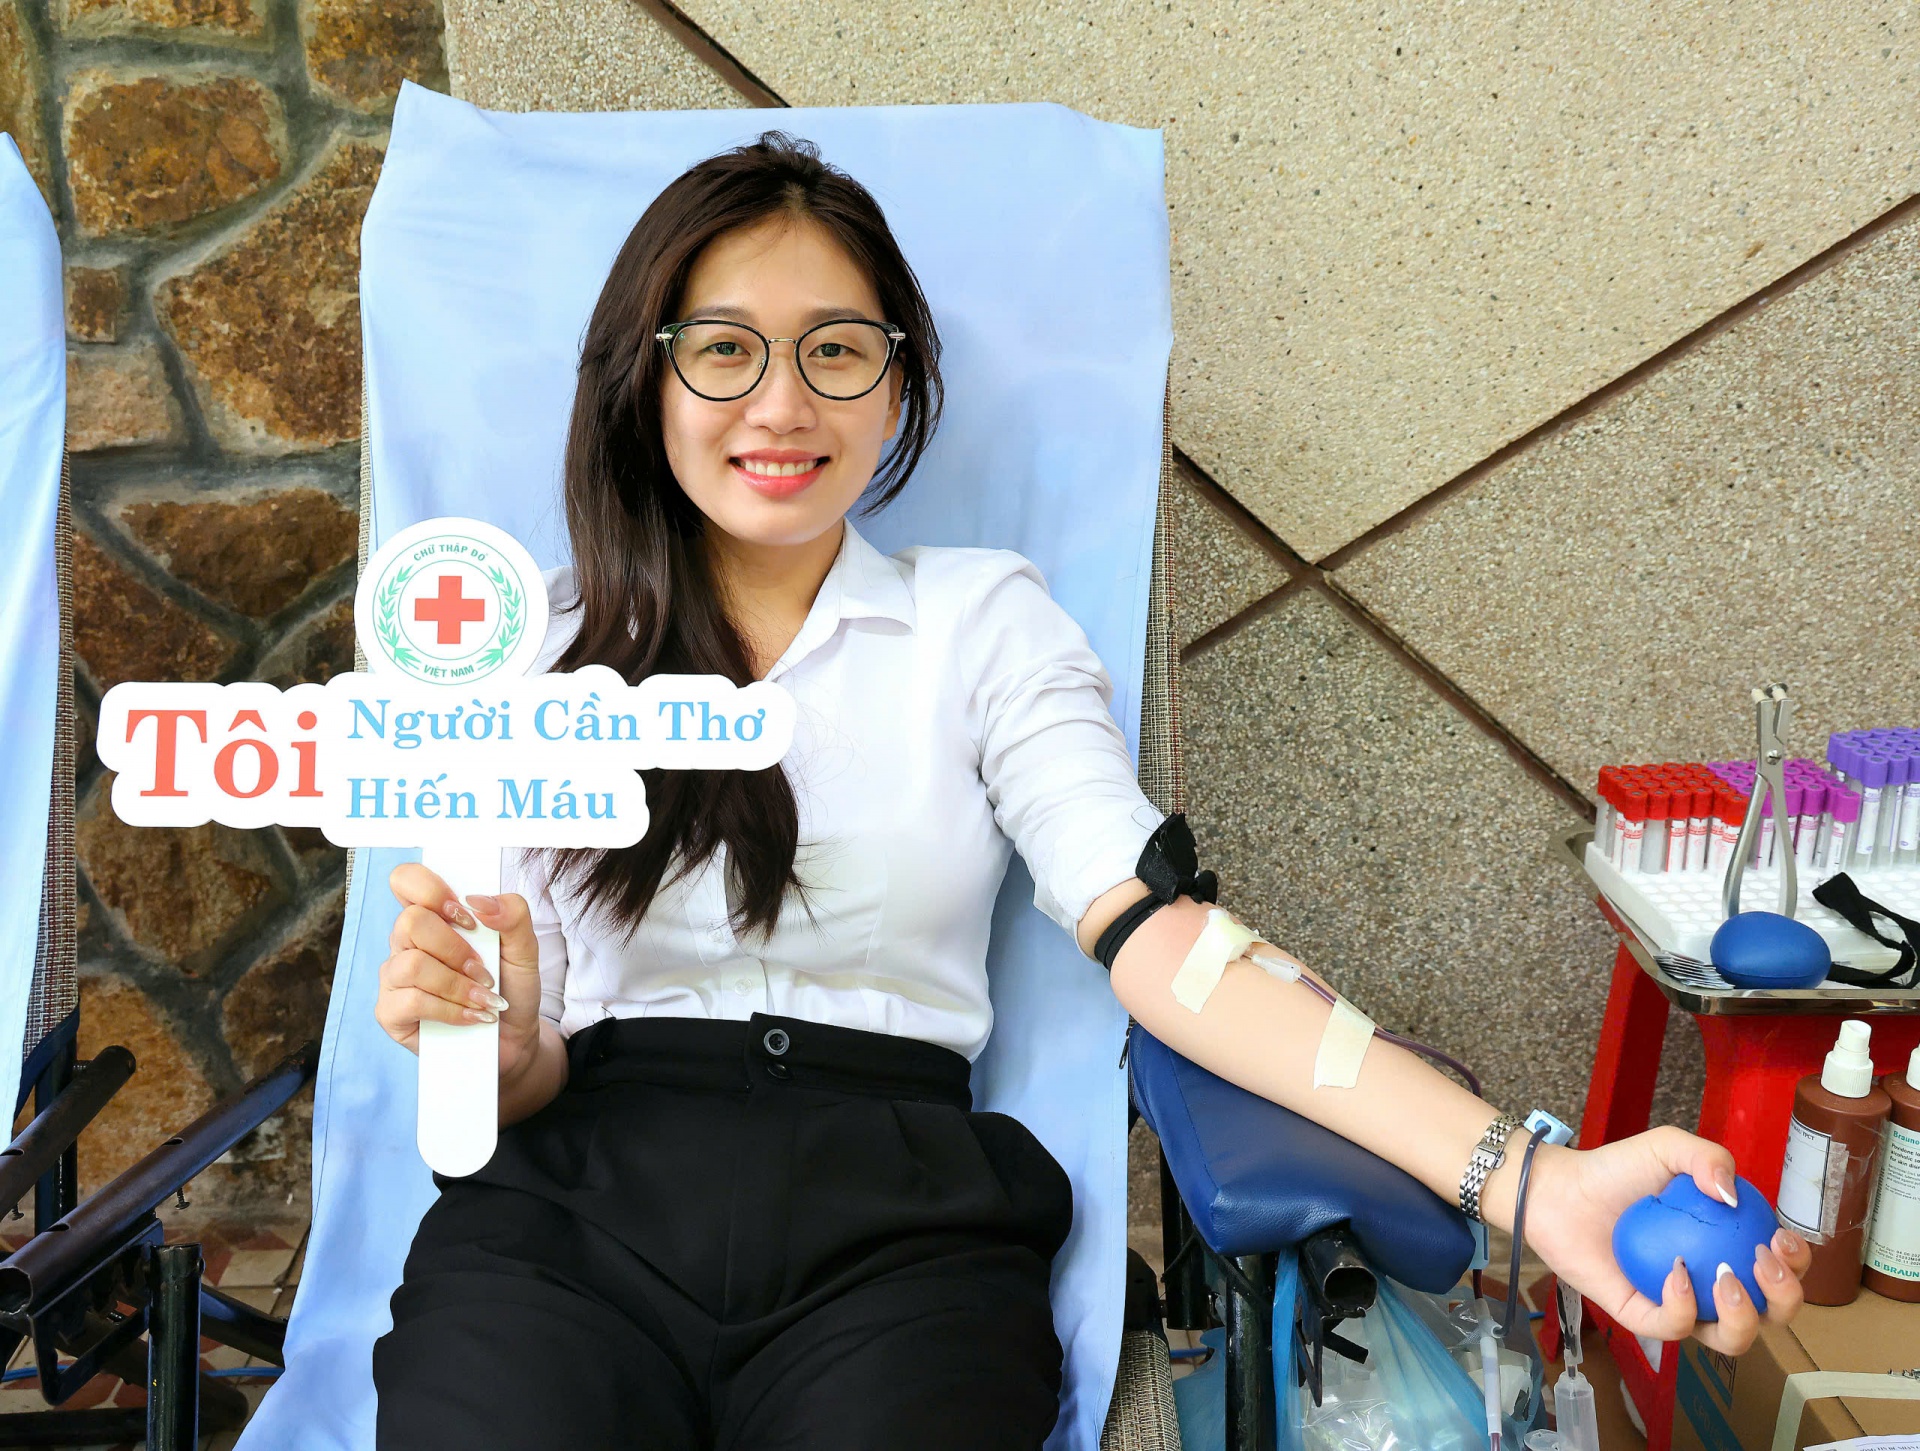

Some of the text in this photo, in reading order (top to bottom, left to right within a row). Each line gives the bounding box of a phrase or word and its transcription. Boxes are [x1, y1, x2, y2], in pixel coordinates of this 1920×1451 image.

[439, 543, 468, 554] THẬP
[424, 664, 475, 678] VIỆT NAM
[347, 691, 767, 750] Người Cần Thơ
[125, 709, 324, 799] Tôi
[346, 773, 618, 820] Hiến Máu
[1874, 1259, 1920, 1277] B BRAUN
